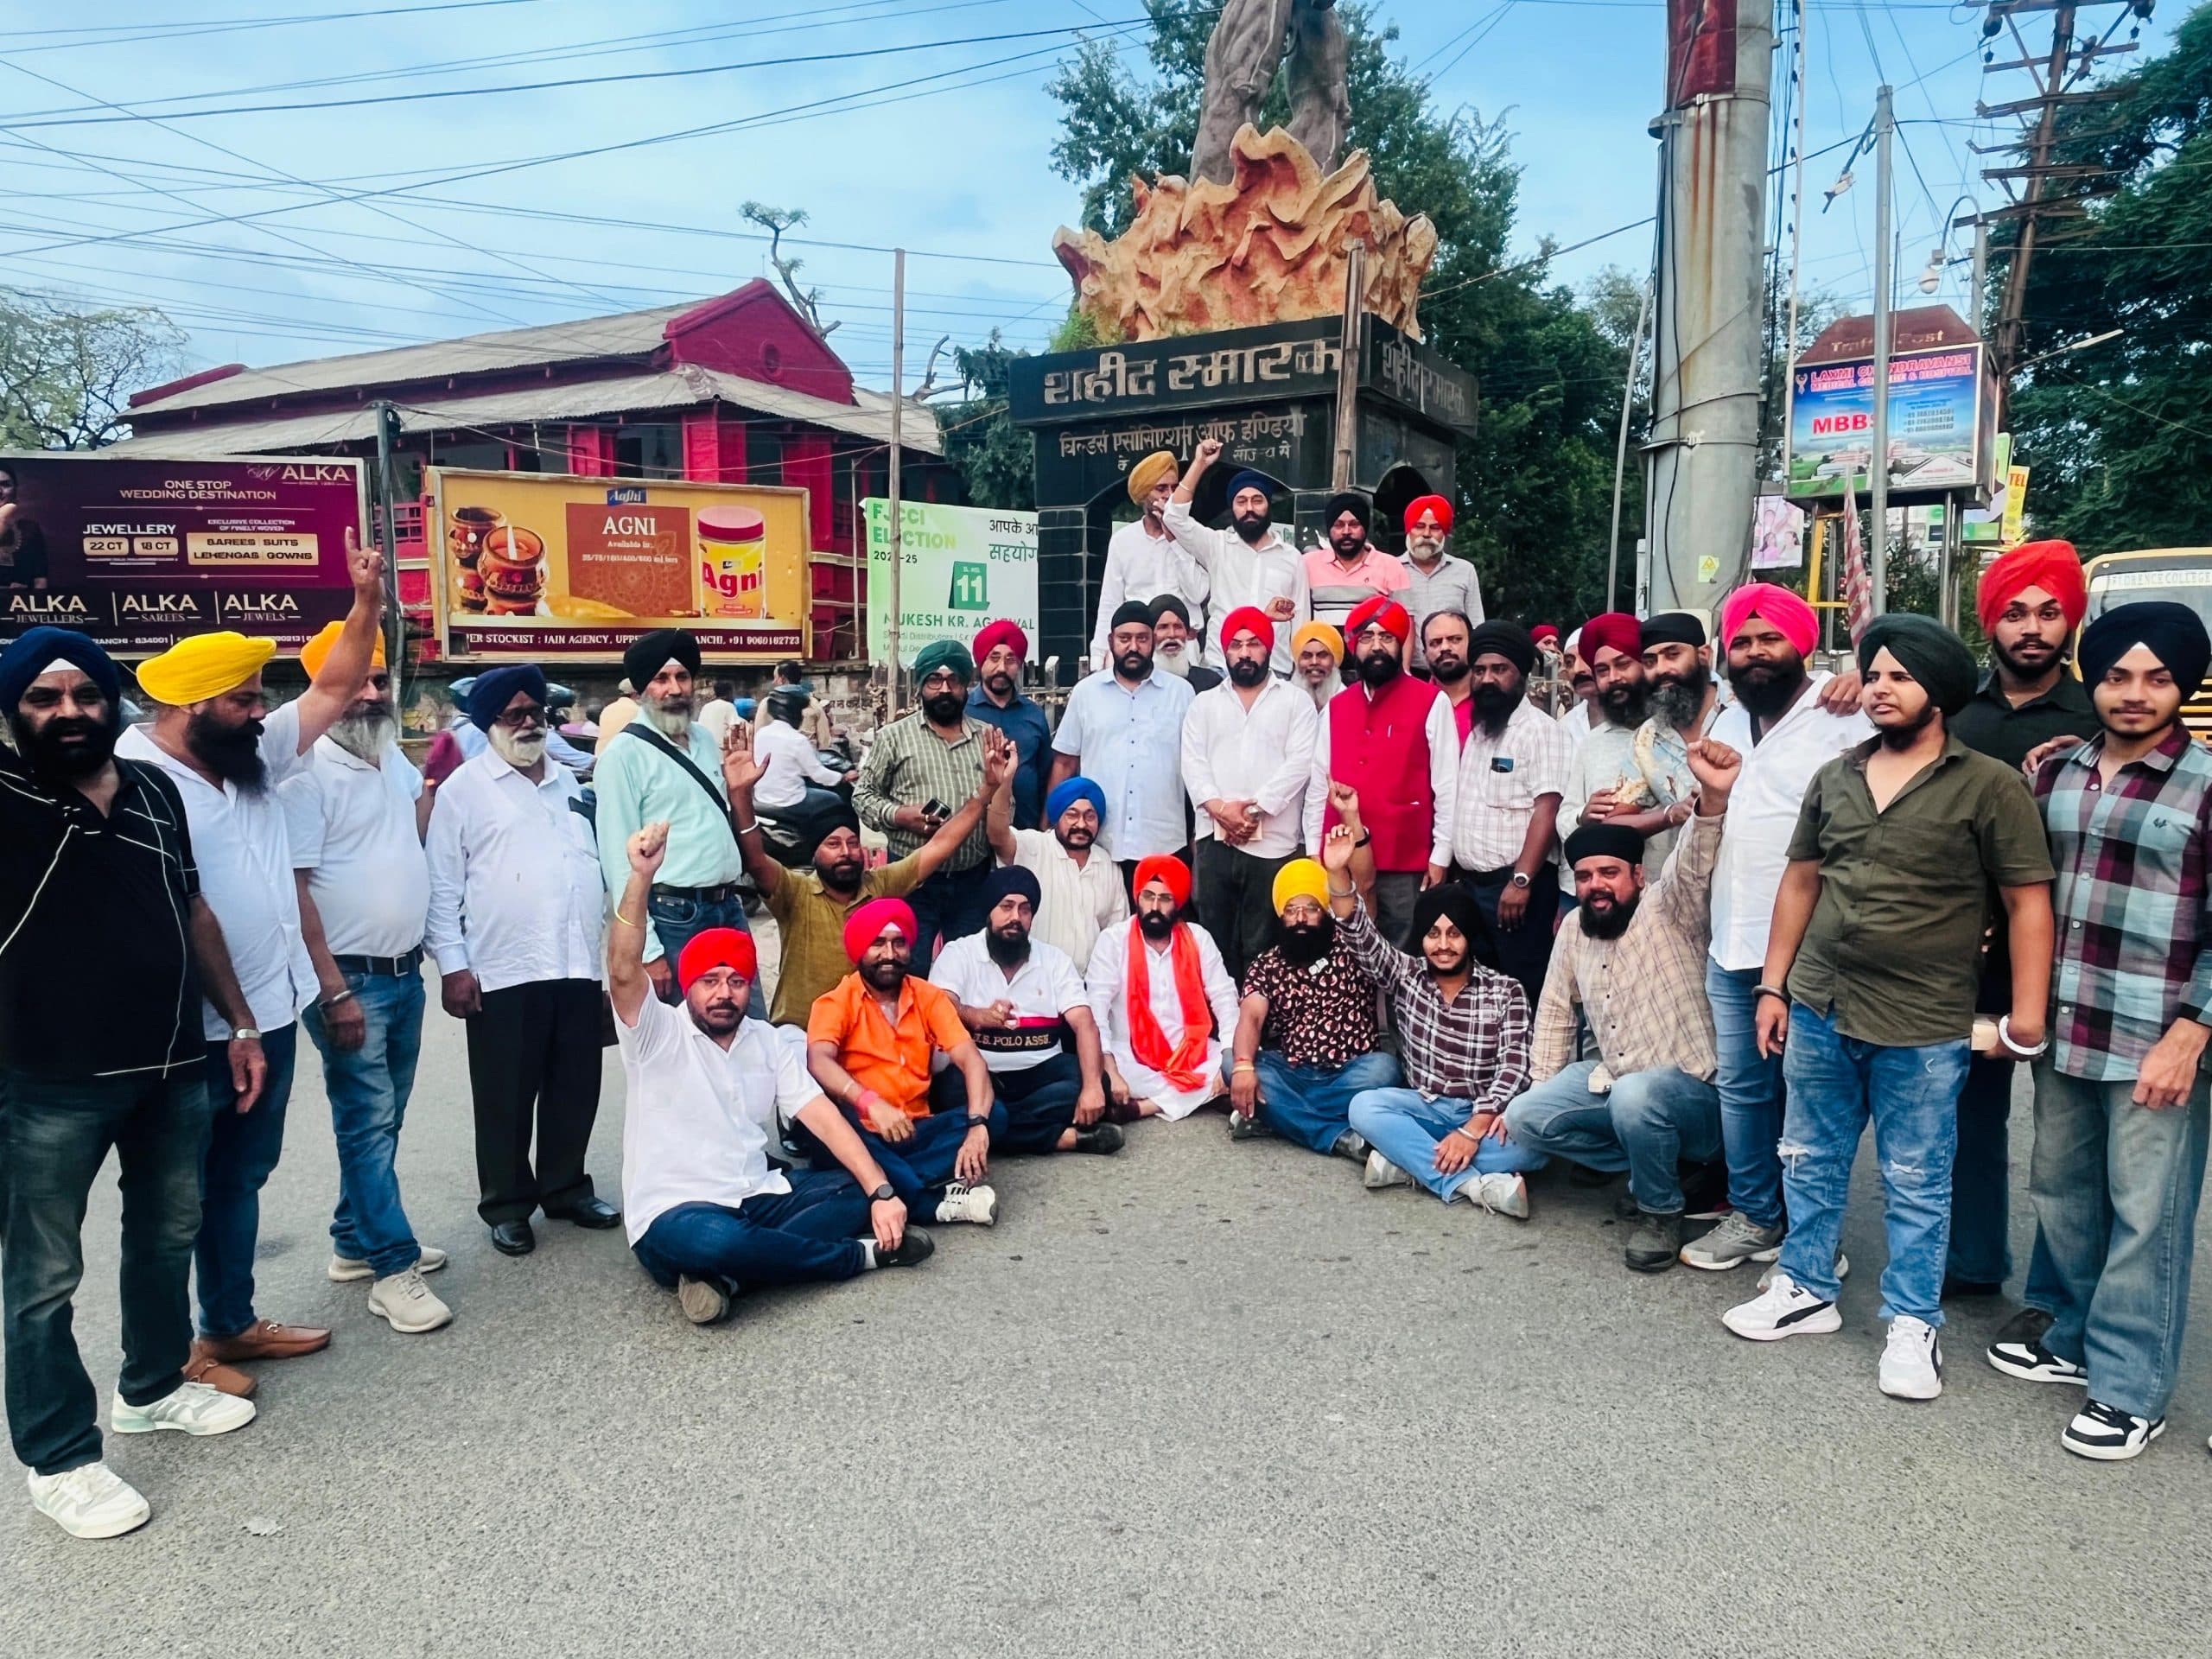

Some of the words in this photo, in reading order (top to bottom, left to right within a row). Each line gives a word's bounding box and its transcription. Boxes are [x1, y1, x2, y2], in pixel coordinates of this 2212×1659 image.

[1044, 352, 1159, 404] शहीद
[1167, 336, 1343, 391] स्मारक
[1810, 366, 1855, 383] LAXMI
[281, 464, 351, 482] ALKA
[164, 480, 194, 490] ONE
[195, 480, 232, 490] STOP
[120, 489, 186, 499] WEDDING
[188, 490, 276, 499] DESTINATION
[83, 524, 176, 535] JEWELLERY
[601, 516, 657, 536] AGNI
[989, 517, 1023, 534] आपके
[873, 526, 957, 550] ELCTION
[89, 542, 105, 550] 22
[107, 541, 124, 550] CT
[141, 542, 153, 550] 18
[156, 541, 171, 550] CT
[988, 540, 1038, 563] सहयोग
[194, 551, 259, 560] LEHENGAS
[874, 550, 918, 563] 202-25
[702, 562, 762, 598] Agni
[957, 574, 982, 602] 11
[10, 594, 88, 613] ALKA
[122, 594, 199, 612] ALKA
[224, 594, 299, 611] ALKA
[16, 614, 84, 624] JEWELLERS
[141, 613, 186, 622] SAREES
[242, 613, 286, 621] JEWELS
[948, 615, 969, 627] KR.
[486, 634, 535, 644] STOCKIST
[993, 1036, 1023, 1046] POLO
